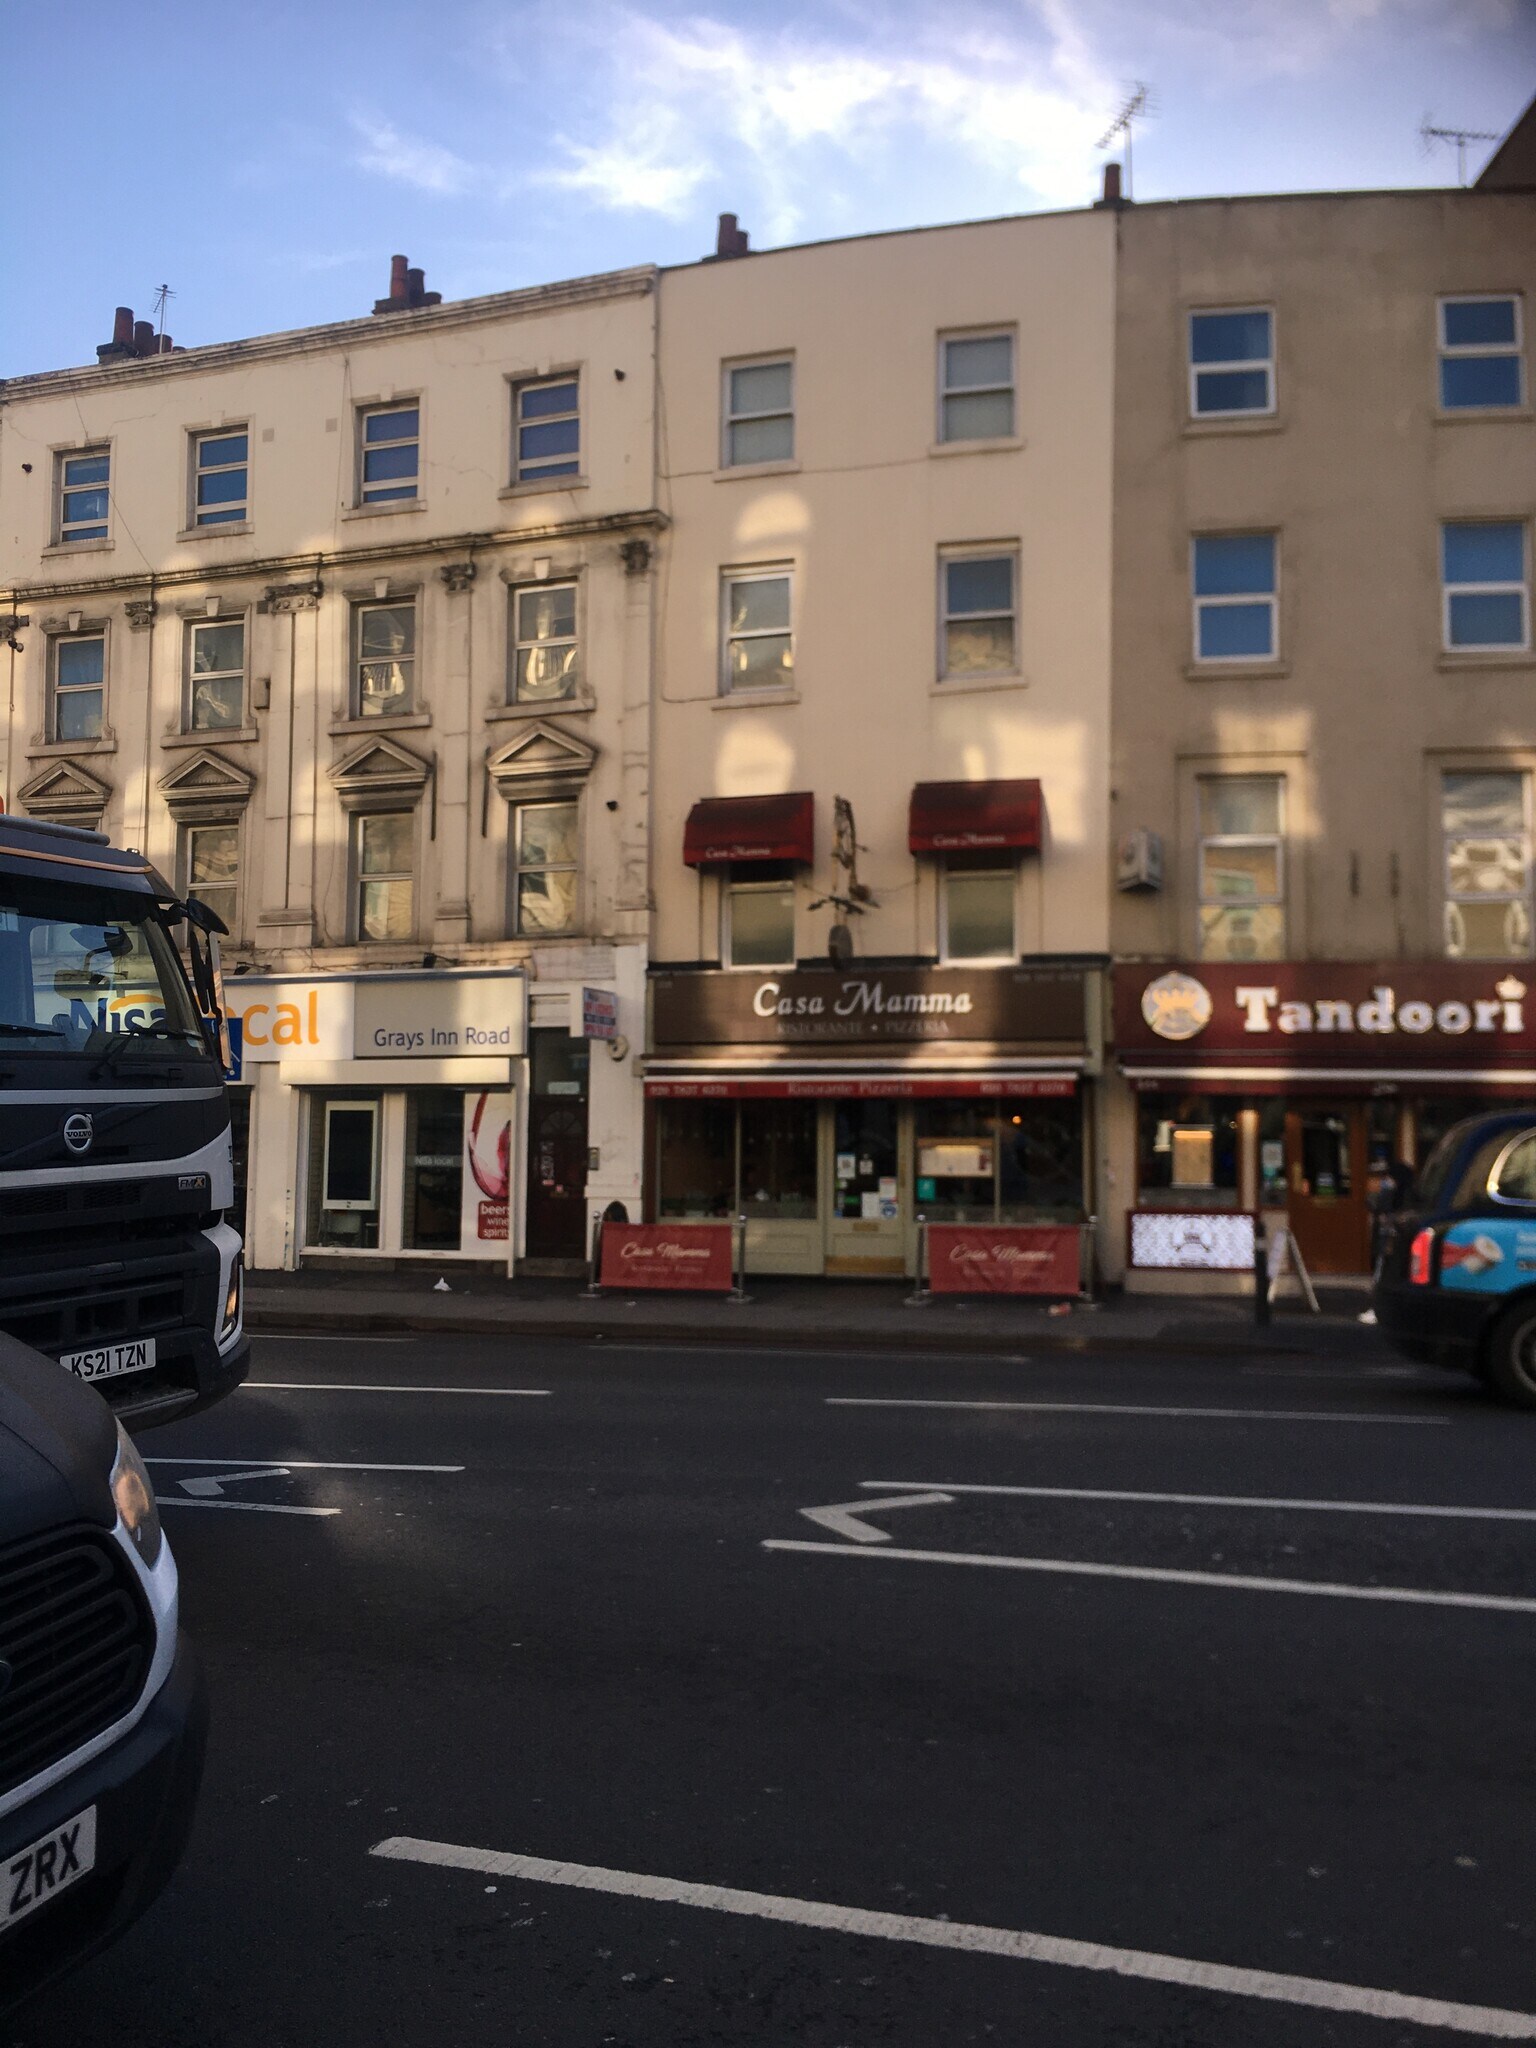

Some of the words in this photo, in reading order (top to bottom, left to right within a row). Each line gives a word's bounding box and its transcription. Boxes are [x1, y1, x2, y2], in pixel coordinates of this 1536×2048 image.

[753, 982, 825, 1017] Casa
[834, 980, 973, 1016] Mamma
[1235, 975, 1527, 1035] Tandoori
[374, 1028, 425, 1050] Grays
[431, 1028, 458, 1045] Inn
[466, 1027, 511, 1045] Road
[71, 1350, 110, 1378] KS21
[115, 1343, 146, 1370] TZN
[9, 1822, 81, 1915] ZRX
